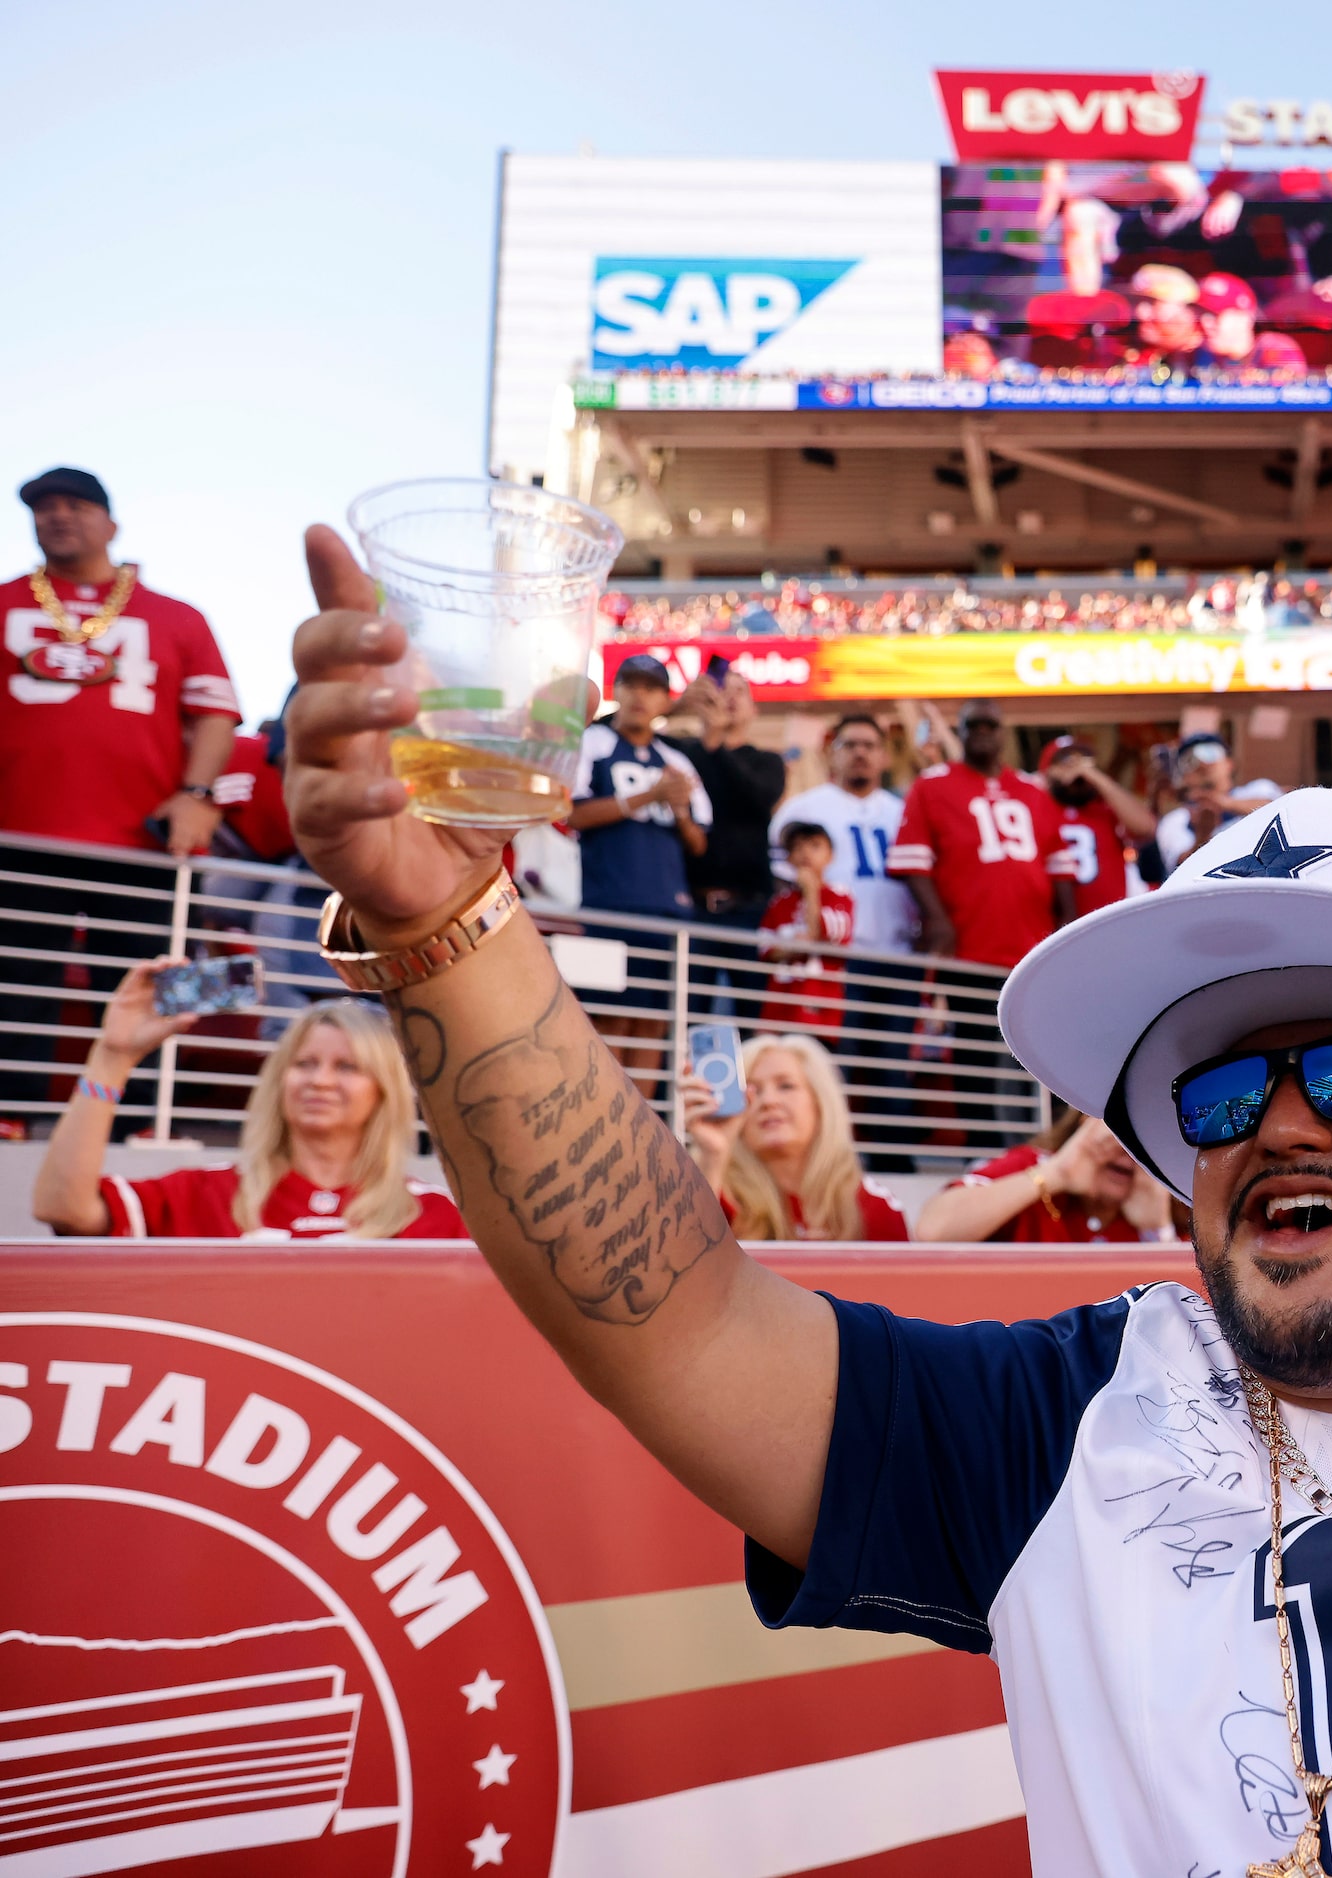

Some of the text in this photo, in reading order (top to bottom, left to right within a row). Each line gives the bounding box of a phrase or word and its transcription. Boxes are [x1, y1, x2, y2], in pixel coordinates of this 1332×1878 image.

[593, 270, 801, 357] SAP
[1014, 638, 1239, 693] Creativity
[968, 796, 1038, 864] 19
[0, 1359, 489, 1651] STADIUM
